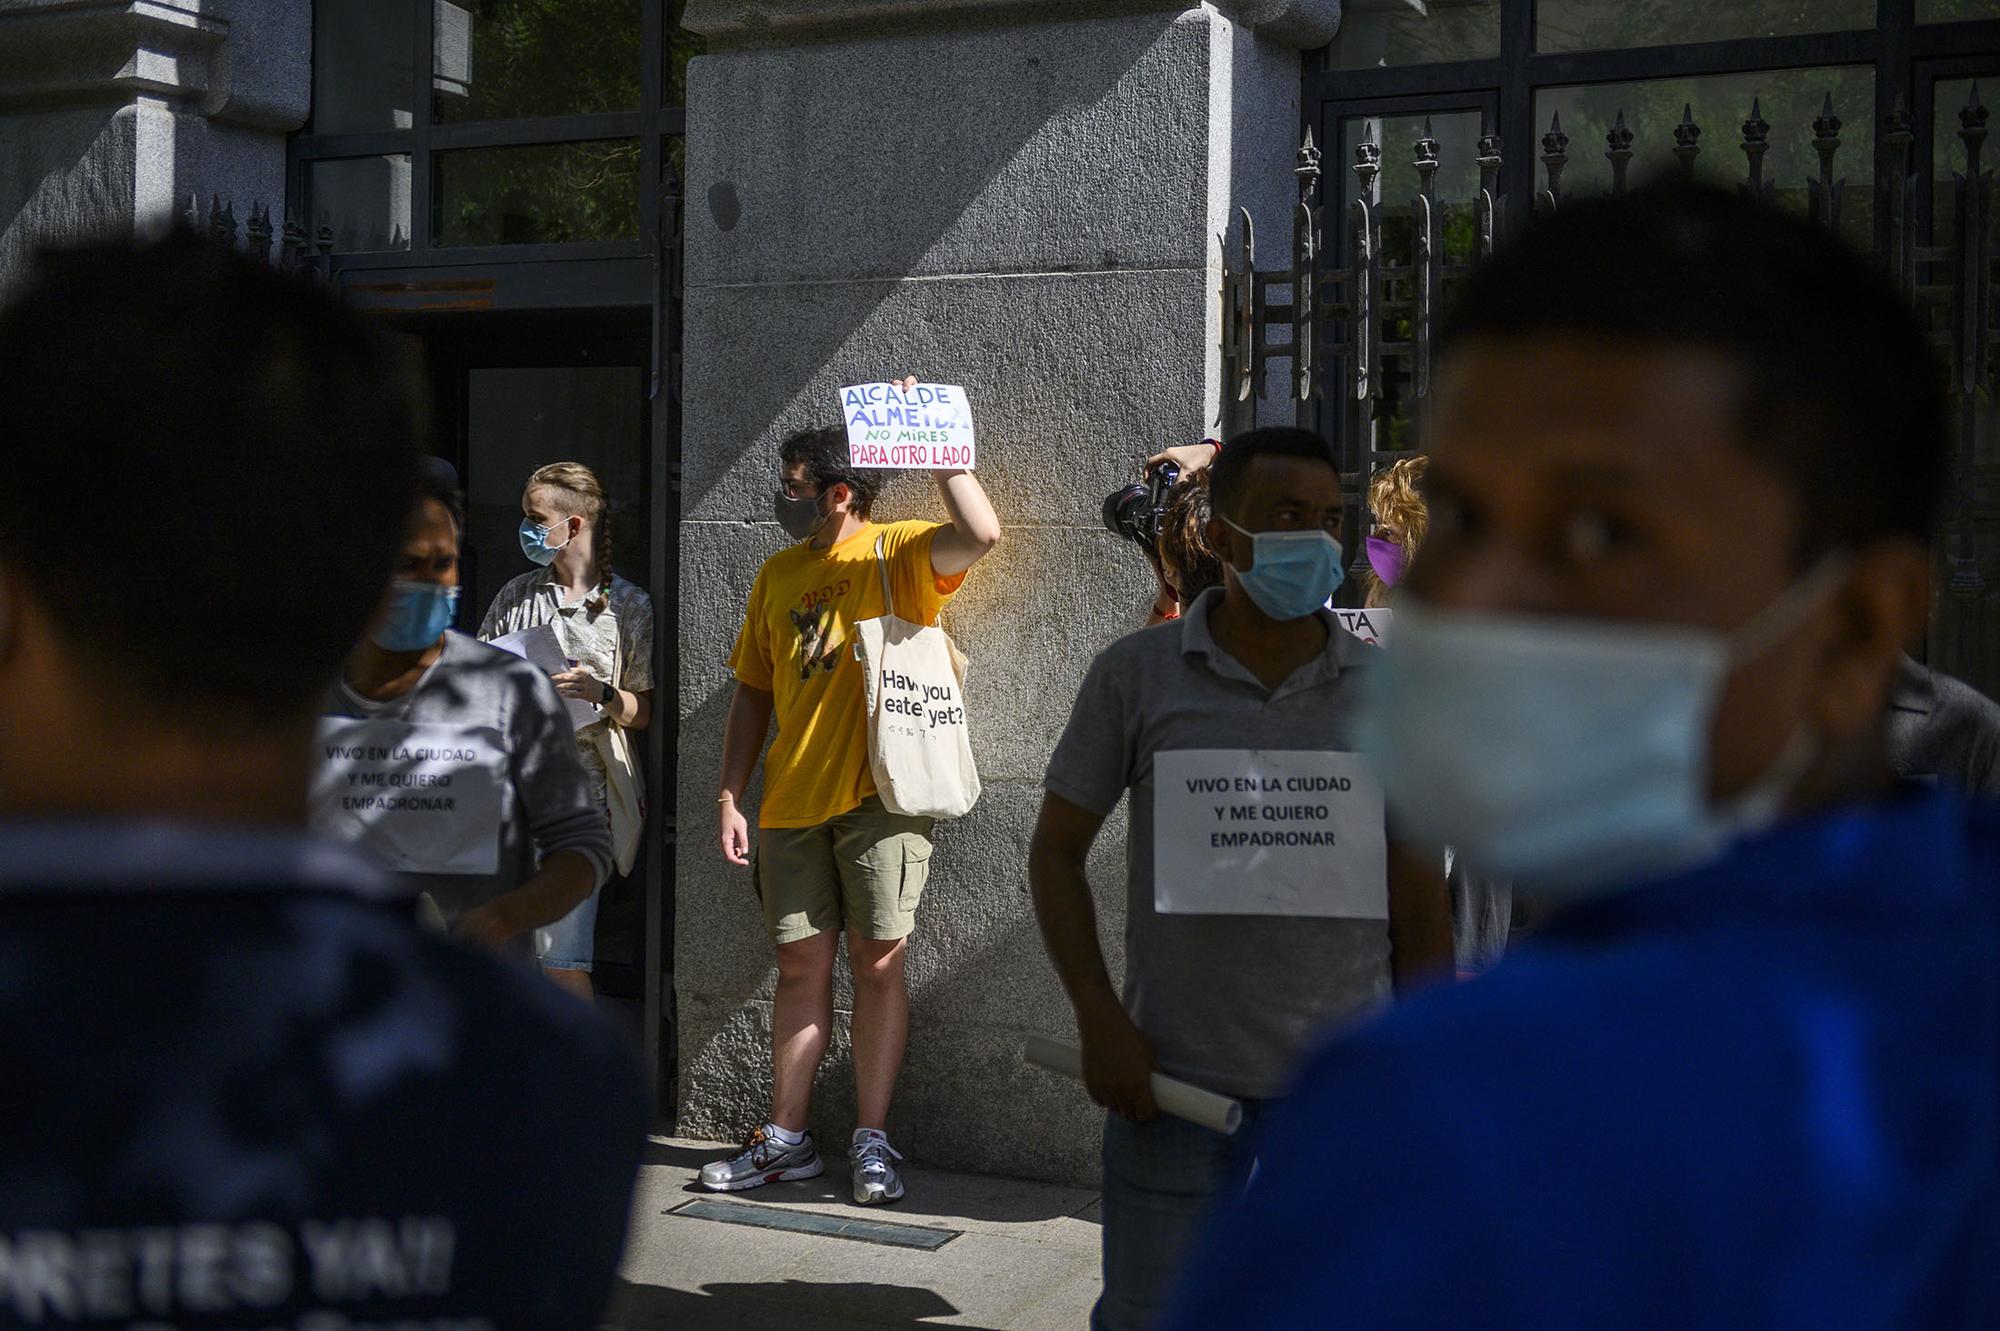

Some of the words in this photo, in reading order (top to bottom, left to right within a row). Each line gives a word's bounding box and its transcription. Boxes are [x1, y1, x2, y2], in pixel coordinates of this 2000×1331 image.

[846, 386, 951, 408] ALCALDE
[865, 430, 890, 441] NO
[851, 444, 888, 465] PARA
[891, 445, 927, 465] OTRO
[932, 445, 971, 466] LADO
[923, 683, 951, 703] you
[885, 697, 926, 718] eate
[929, 707, 963, 728] yet?
[325, 747, 362, 761] VIVO
[367, 747, 388, 760] EN
[392, 748, 410, 761] LA
[415, 748, 476, 762] CIUDAD
[348, 773, 357, 786] Y
[361, 773, 384, 786] ME
[389, 774, 451, 788] QUIERO
[1186, 778, 1229, 793] VIVO
[1234, 778, 1257, 792] EN
[1261, 778, 1282, 792] LA
[1286, 777, 1351, 792] CIUDAD
[343, 797, 455, 811] EMPADRONAR
[1214, 806, 1225, 820] Y
[1230, 806, 1257, 820] ME
[1262, 805, 1329, 822] QUIERO
[1210, 832, 1336, 848] EMPADRONAR
